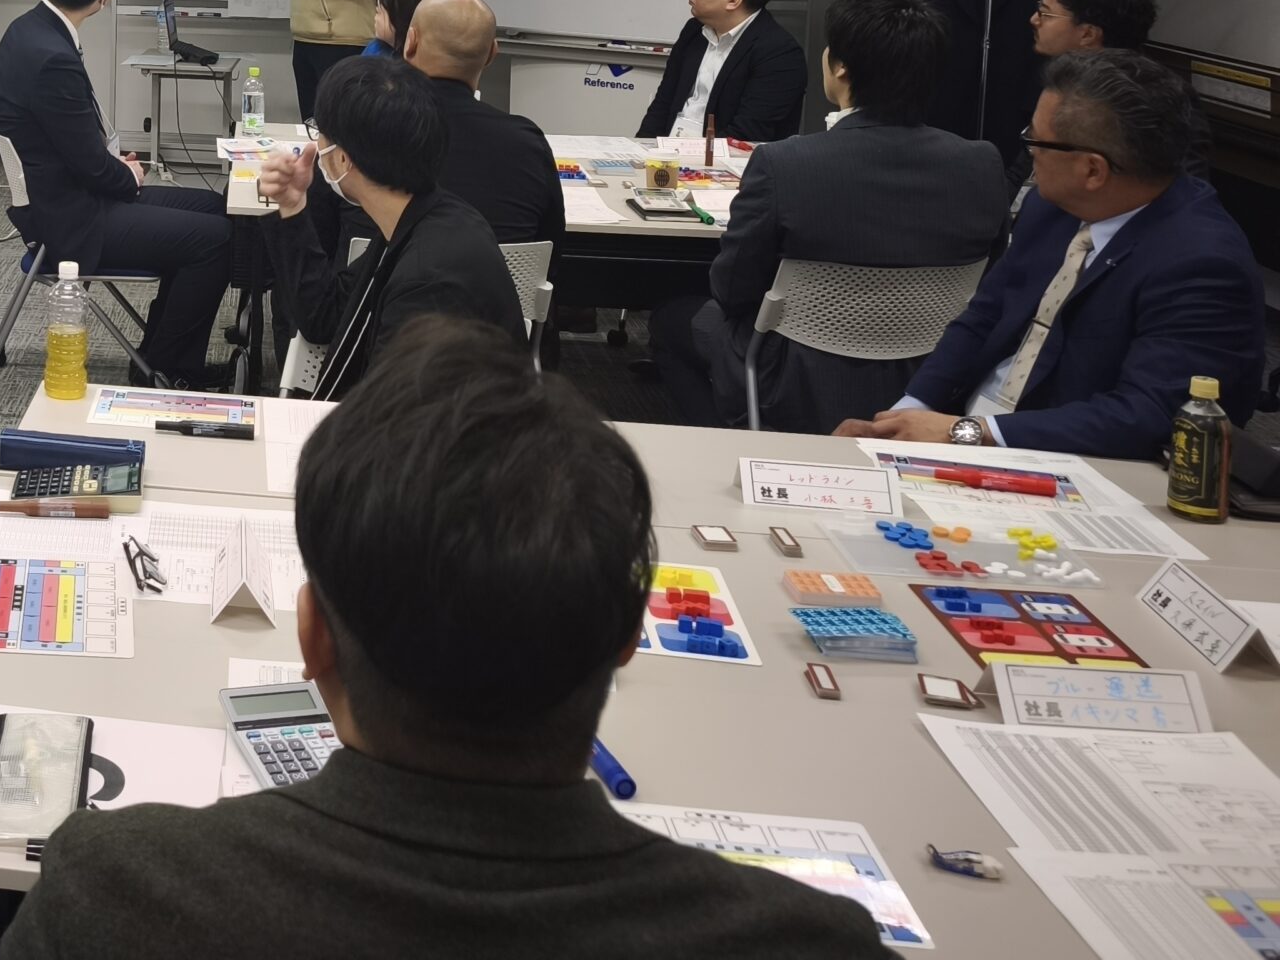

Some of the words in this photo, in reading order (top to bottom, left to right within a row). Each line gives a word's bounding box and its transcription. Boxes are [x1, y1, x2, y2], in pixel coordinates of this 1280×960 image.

[584, 77, 635, 90] Reference
[760, 486, 789, 500] 社長
[1150, 588, 1173, 609] 社長
[1023, 699, 1063, 718] 社長
